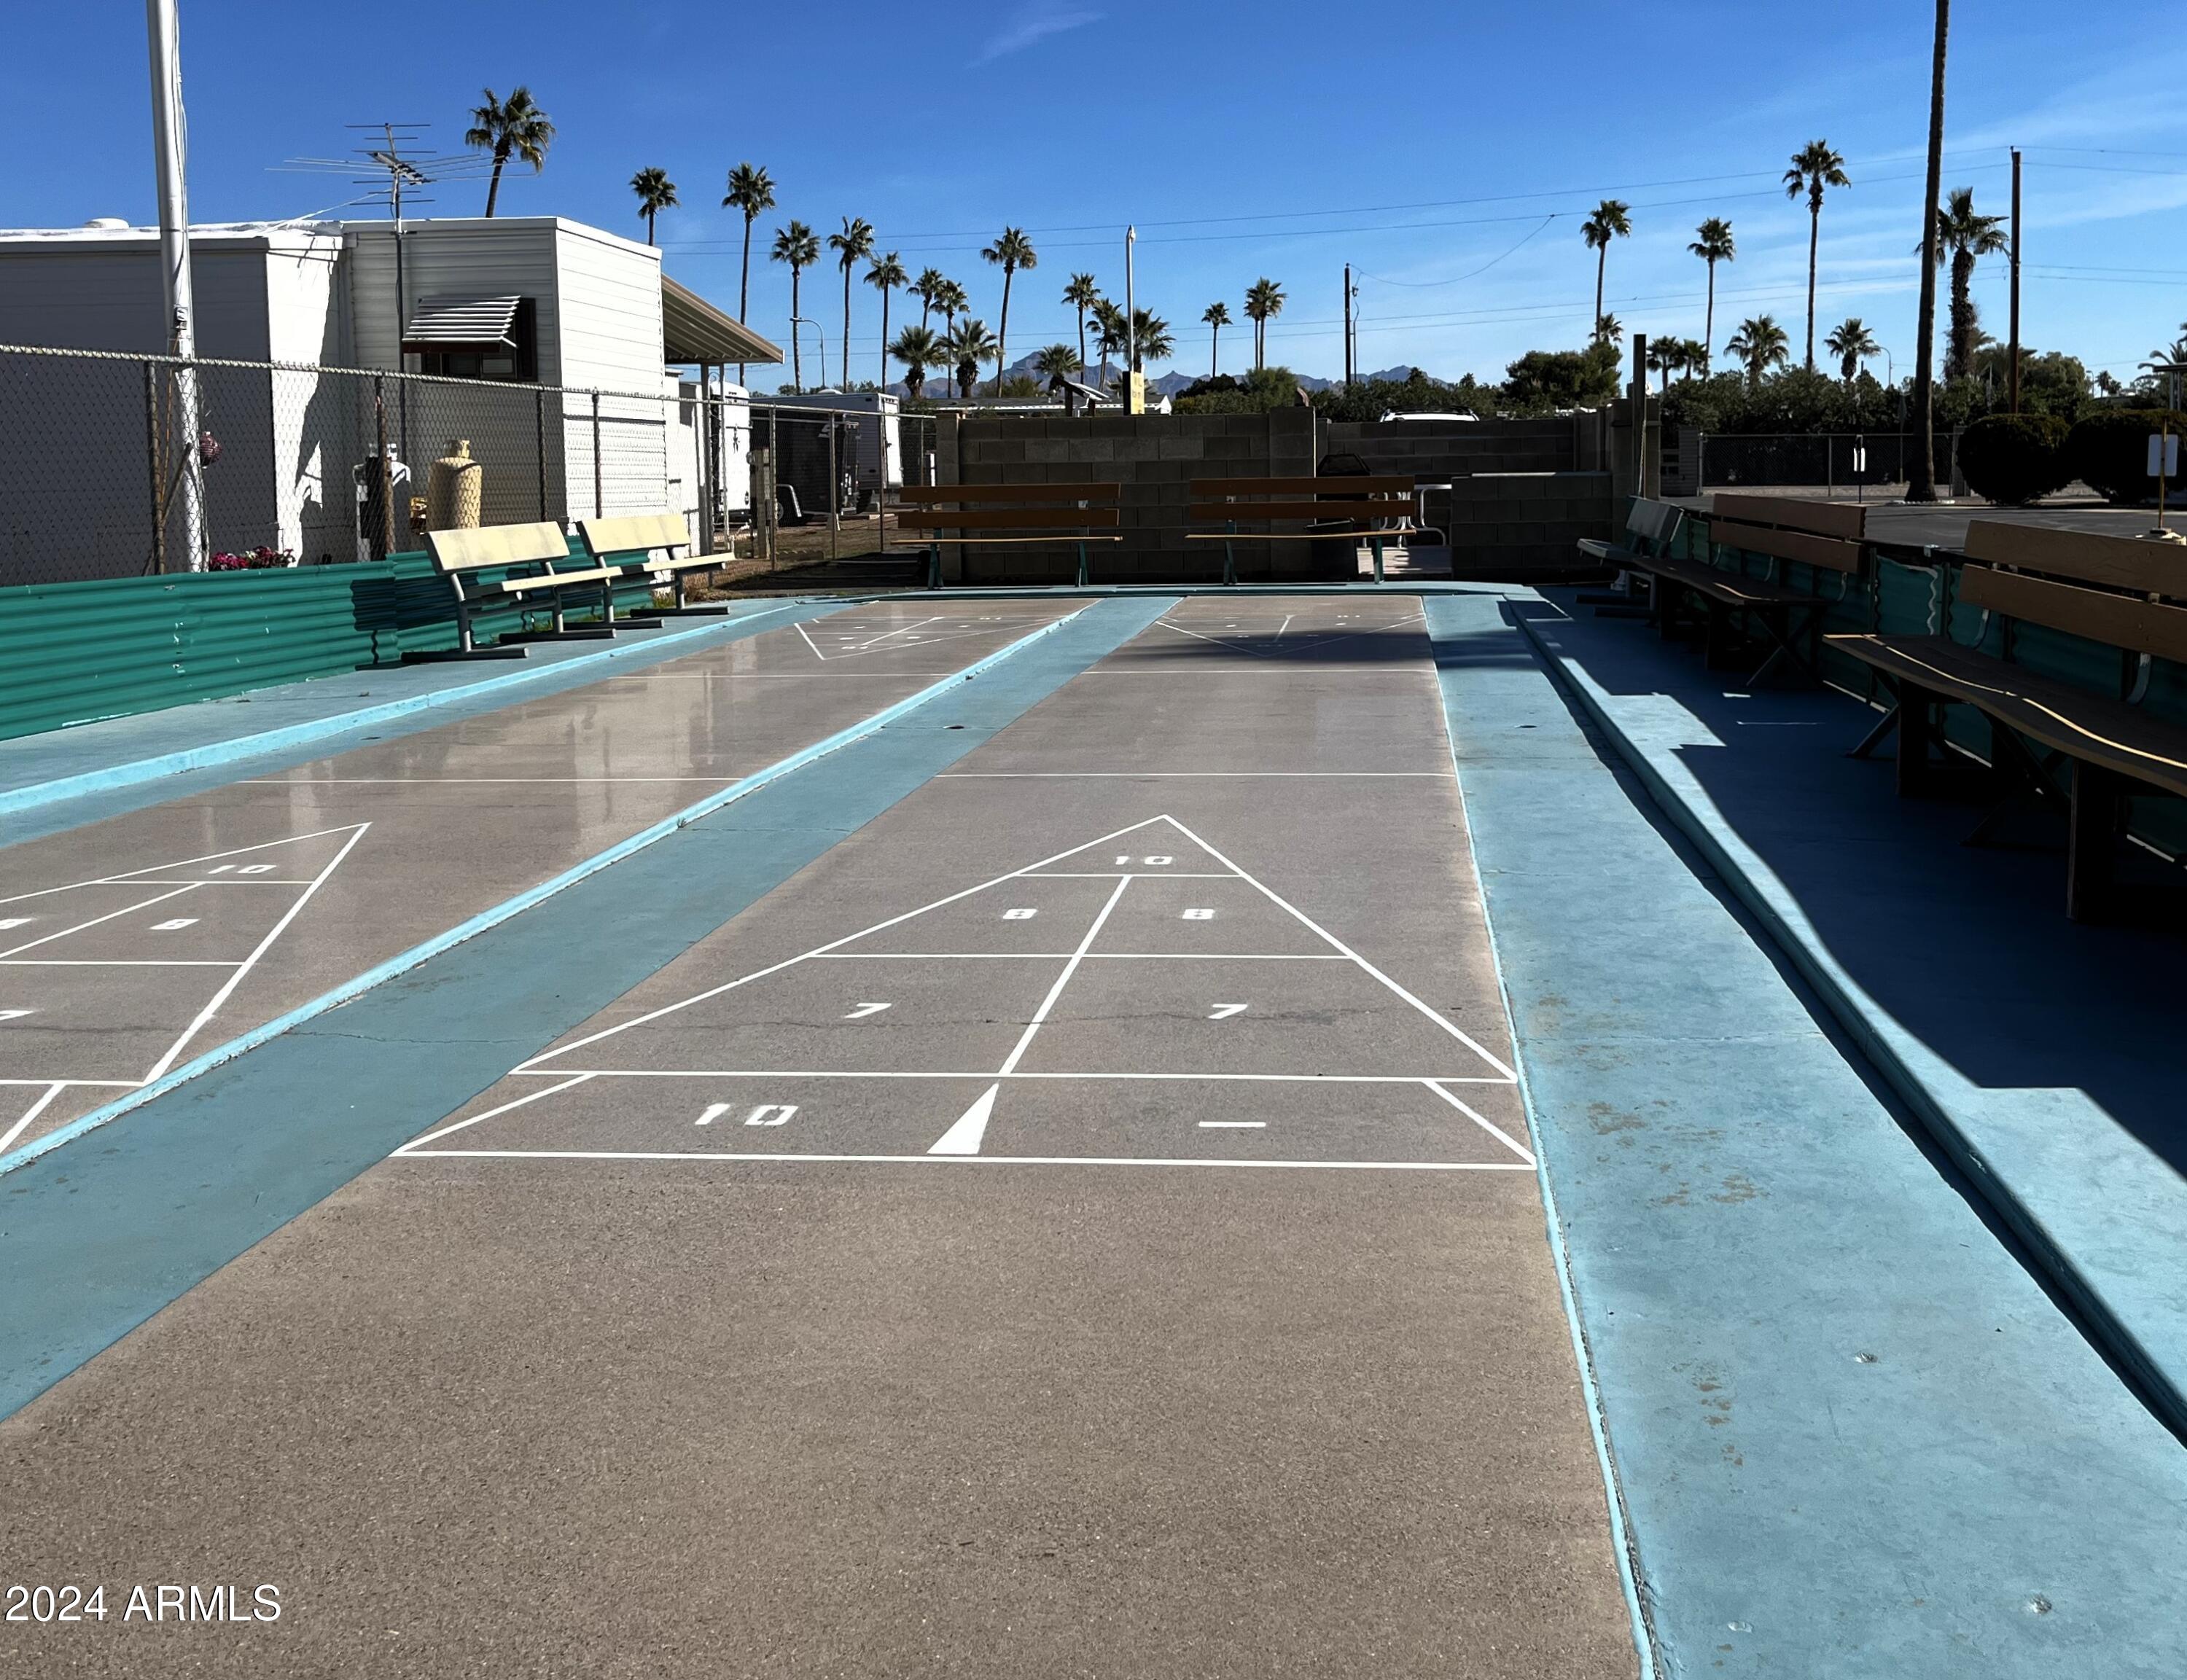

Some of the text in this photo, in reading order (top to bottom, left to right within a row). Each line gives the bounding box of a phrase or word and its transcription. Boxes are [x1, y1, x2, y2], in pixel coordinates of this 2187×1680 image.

[1115, 856, 1174, 865] 10
[1002, 908, 1038, 920] 8
[1181, 908, 1217, 920] 8
[844, 1002, 892, 1019] 7
[1208, 1003, 1249, 1020] 7
[694, 1103, 799, 1126] 10
